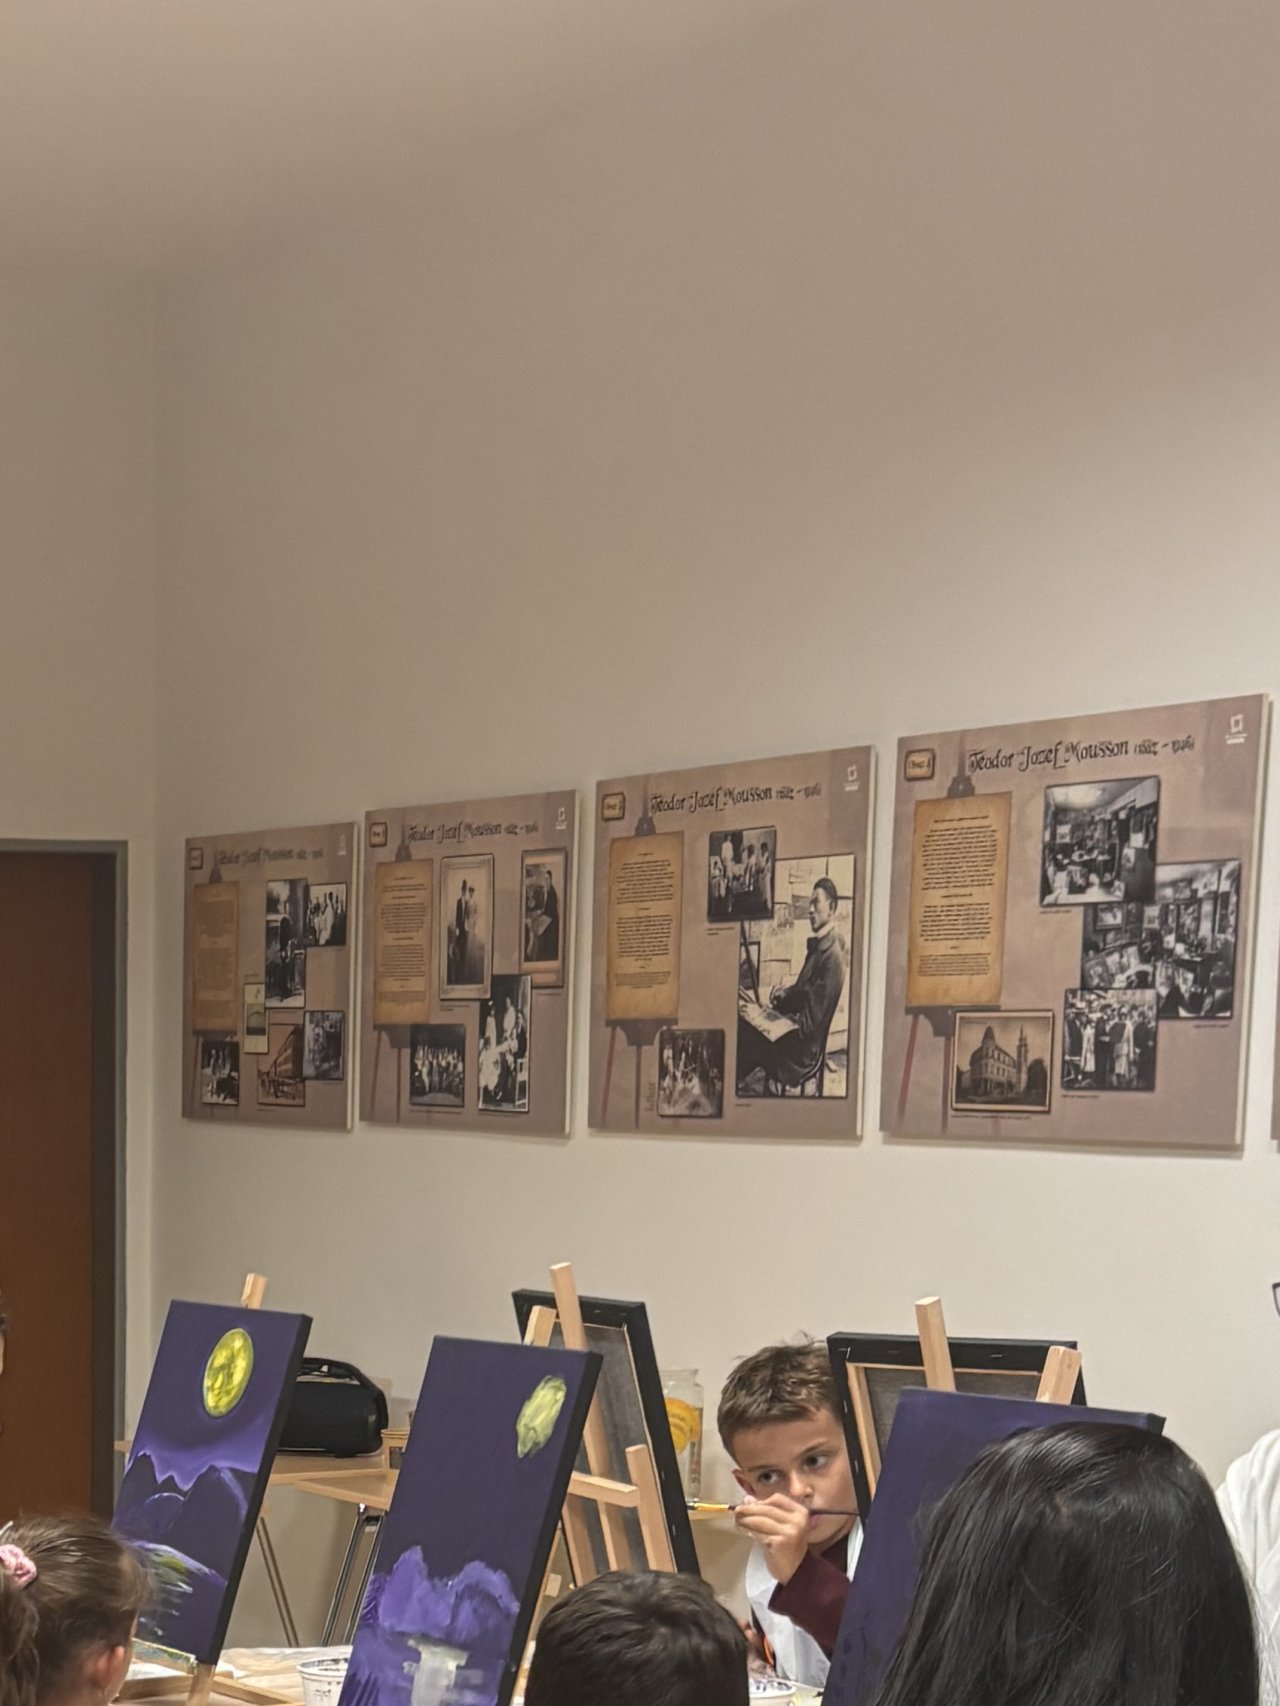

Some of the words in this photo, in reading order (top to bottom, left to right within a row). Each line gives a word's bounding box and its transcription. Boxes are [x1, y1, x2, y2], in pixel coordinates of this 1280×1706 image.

[969, 750, 1014, 772] Teodor
[1018, 741, 1065, 772] Jozef
[1065, 741, 1128, 763] Mousson
[651, 794, 686, 813] Teodor
[723, 787, 772, 805] Mousson
